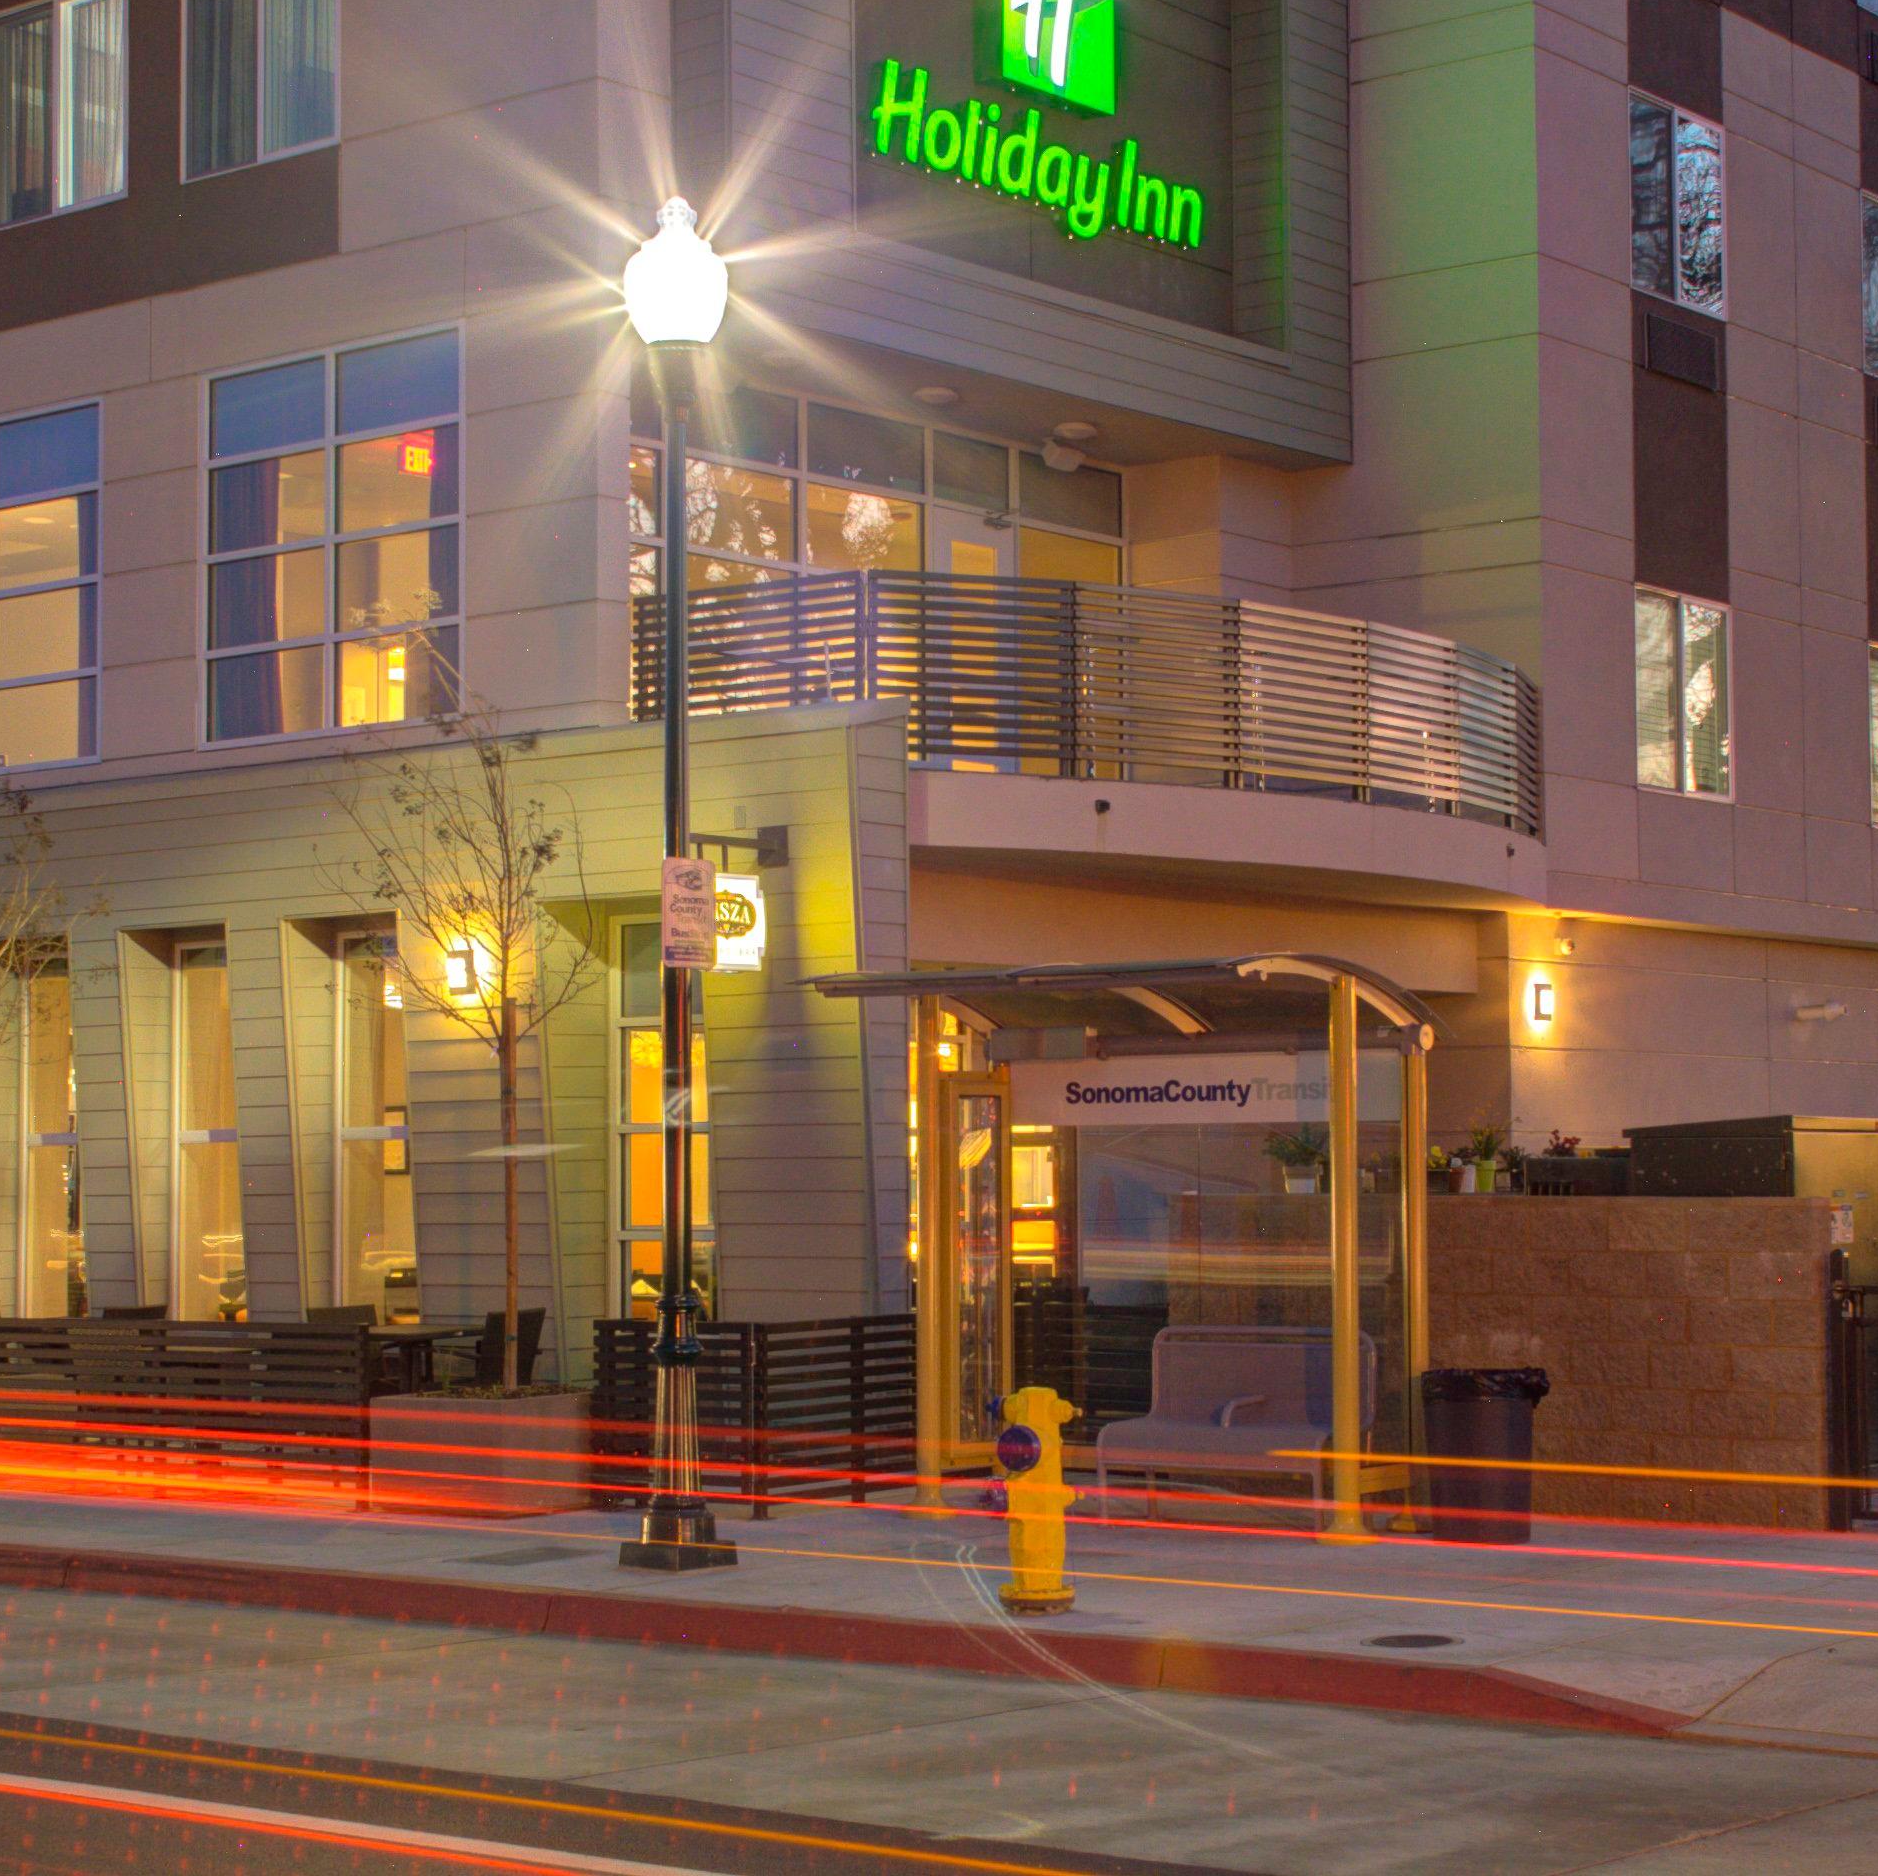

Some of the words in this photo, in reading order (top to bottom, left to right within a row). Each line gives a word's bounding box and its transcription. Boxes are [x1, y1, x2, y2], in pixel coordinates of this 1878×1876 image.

[872, 58, 1109, 240] Holiday
[1117, 138, 1203, 249] Inn
[670, 904, 703, 918] County
[1065, 1079, 1251, 1107] SonomaCounty
[1251, 1076, 1331, 1101] Transi
